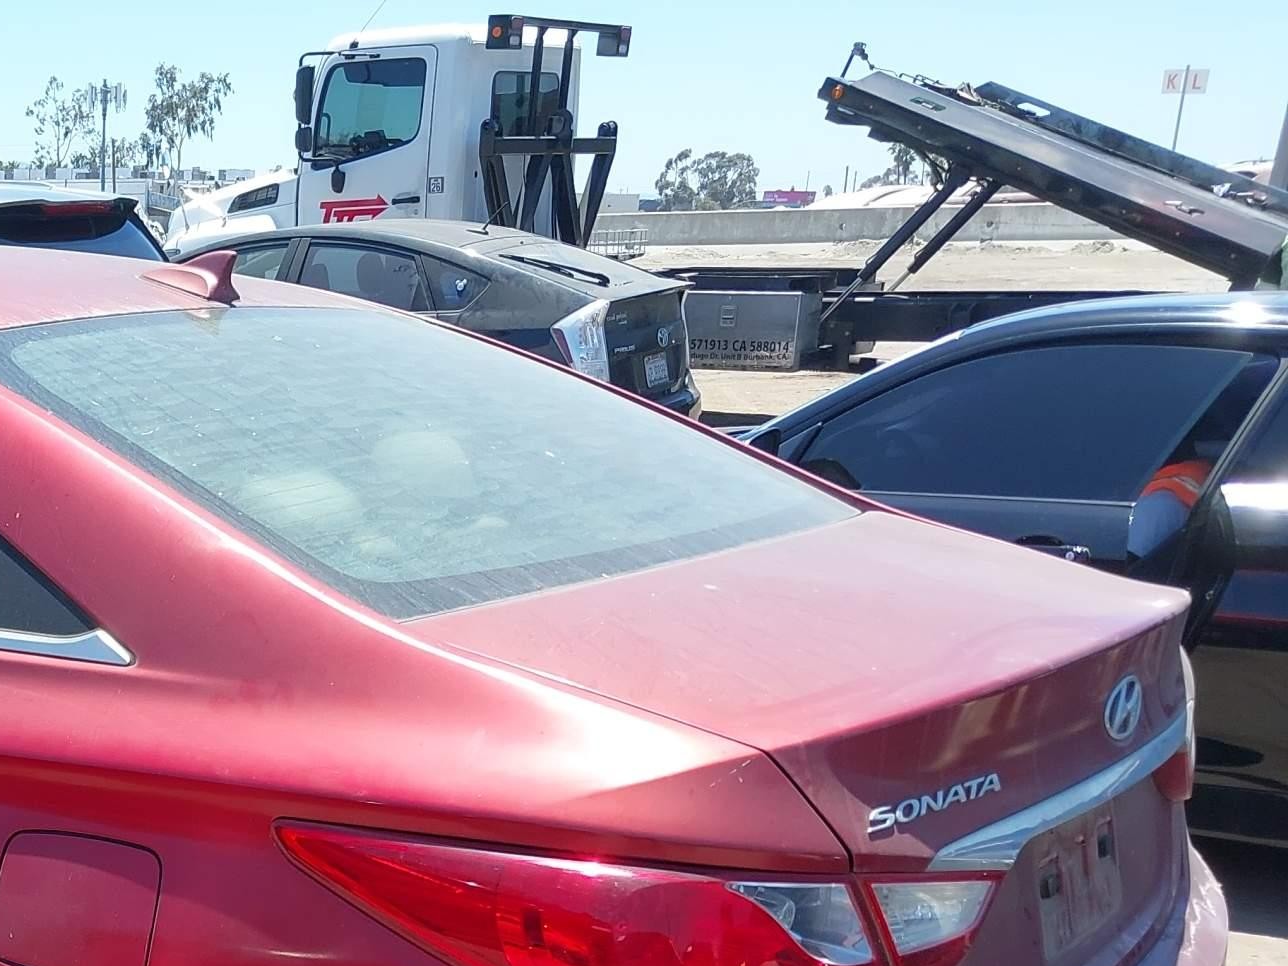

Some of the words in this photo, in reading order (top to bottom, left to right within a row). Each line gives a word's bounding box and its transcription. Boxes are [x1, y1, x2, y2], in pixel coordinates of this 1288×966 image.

[1166, 73, 1178, 90] K
[1191, 73, 1201, 90] L
[431, 182, 441, 192] 26
[690, 338, 729, 351] 571913
[732, 339, 746, 352] CA
[749, 340, 789, 353] 588014
[867, 773, 1002, 834] SONATA
